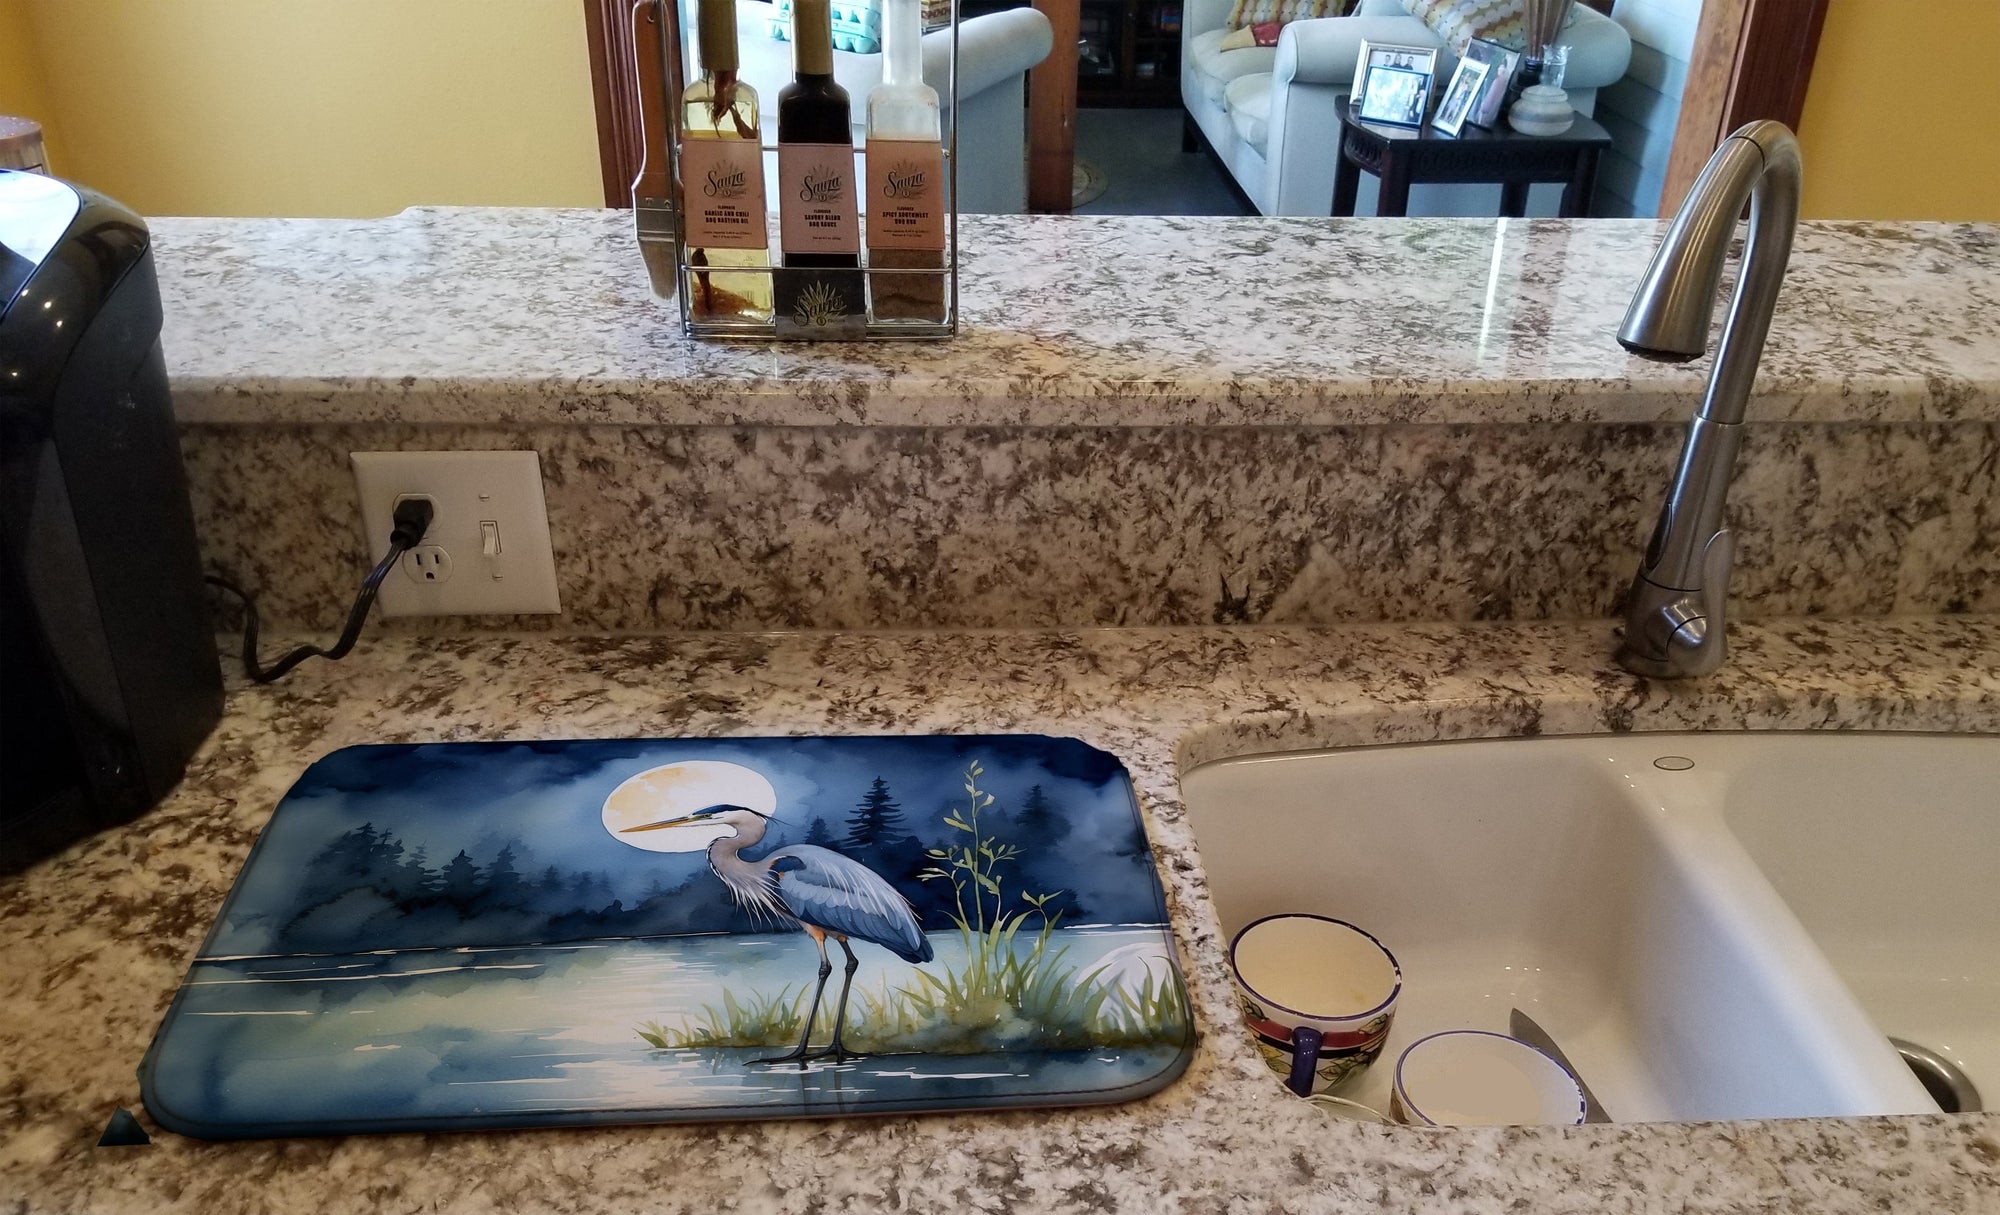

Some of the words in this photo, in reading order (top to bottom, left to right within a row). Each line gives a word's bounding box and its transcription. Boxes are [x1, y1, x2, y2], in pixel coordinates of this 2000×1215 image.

[703, 170, 745, 197] Sauza
[800, 175, 840, 201] Sauza
[884, 171, 925, 198] Sauza
[793, 295, 845, 326] Sauza
